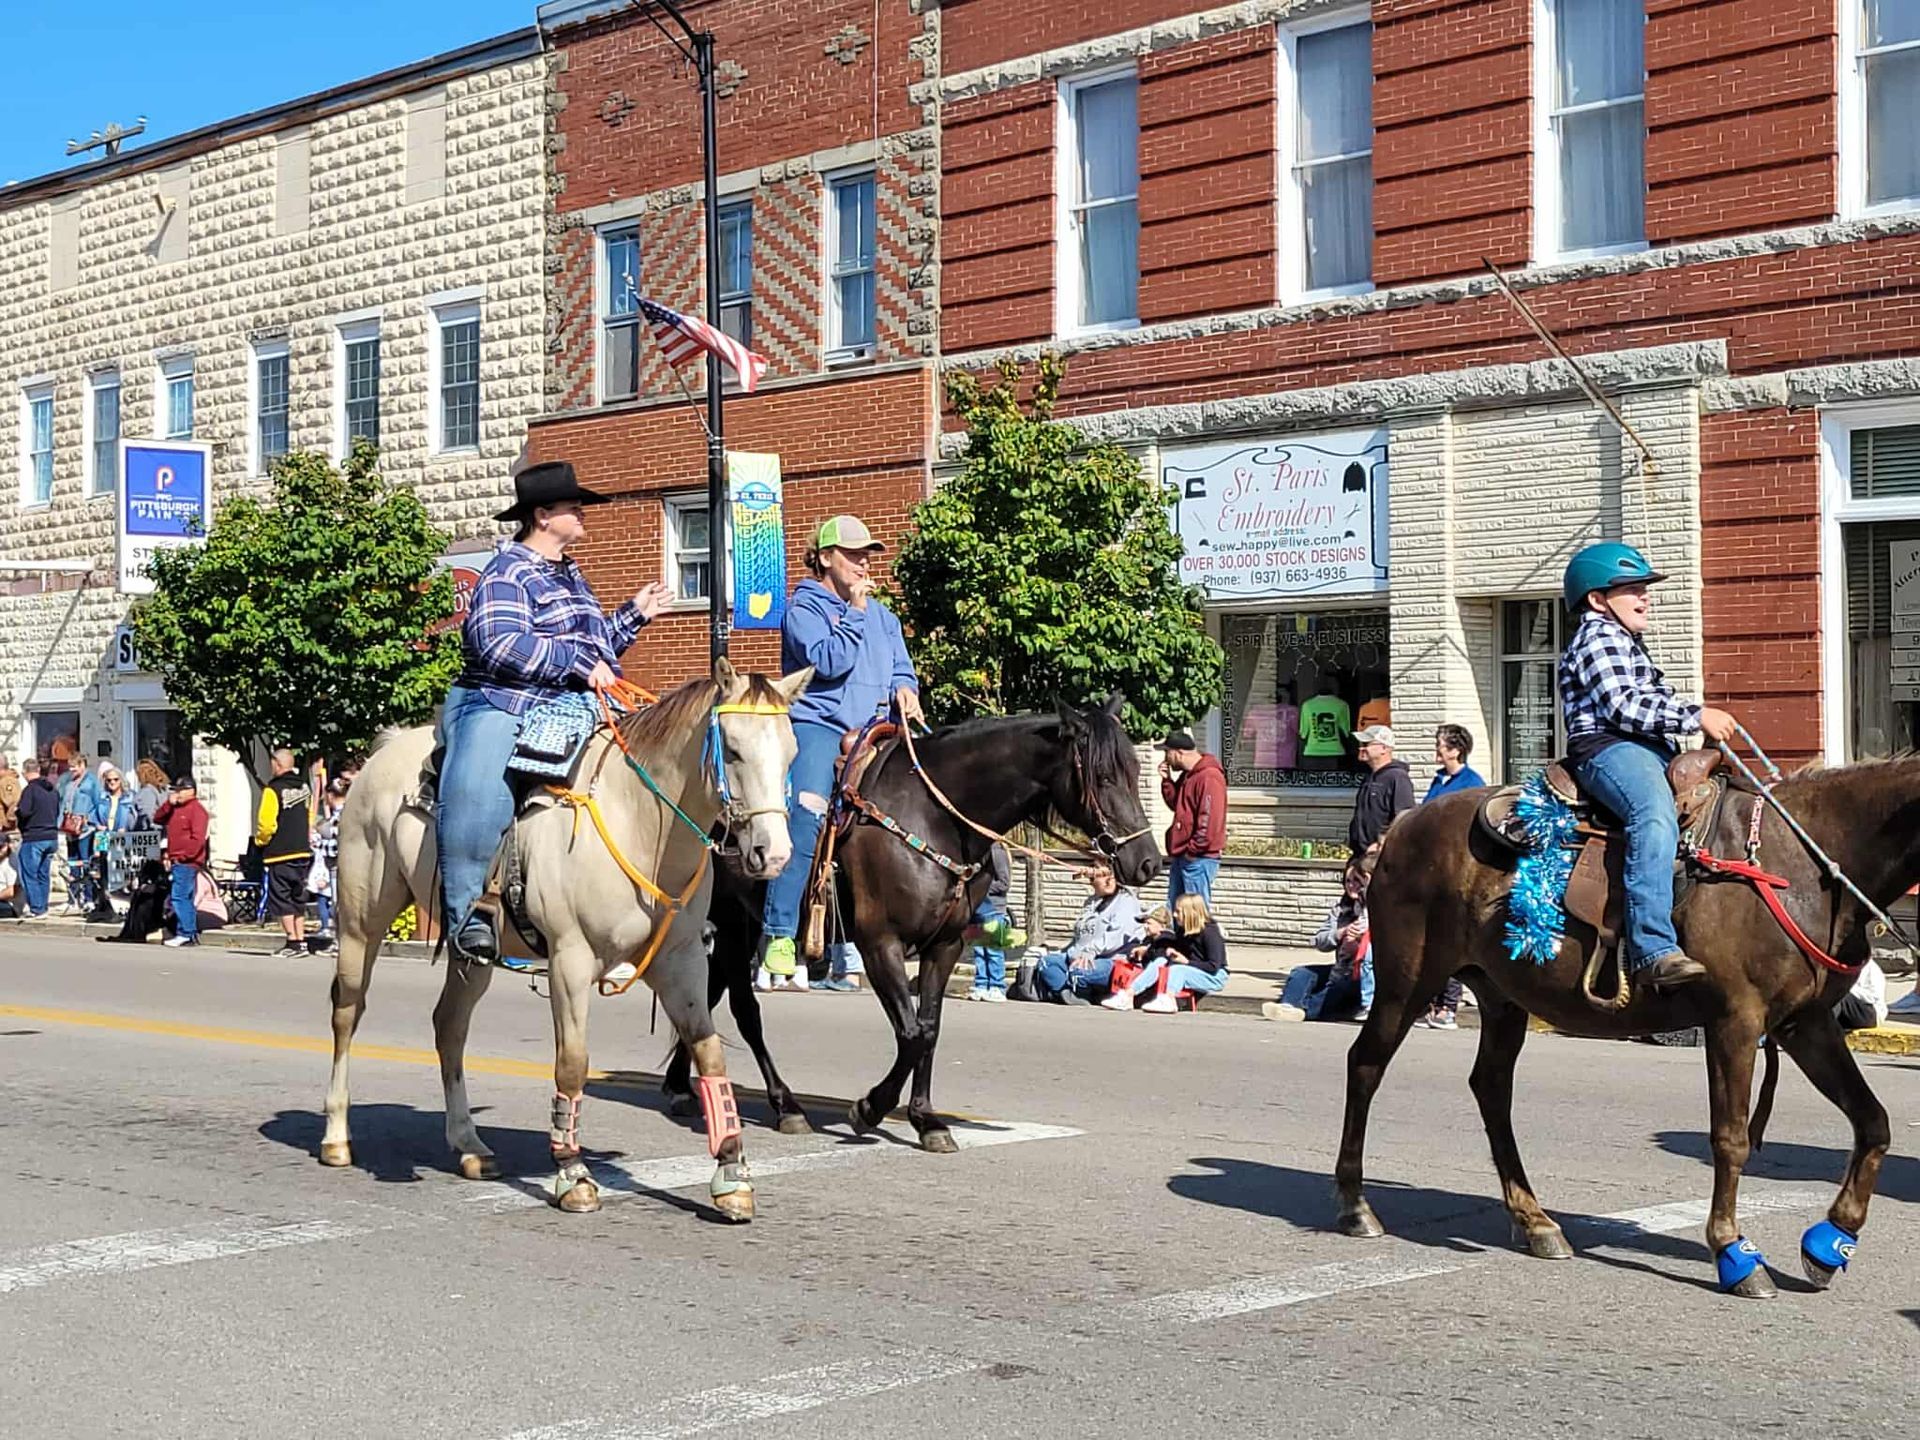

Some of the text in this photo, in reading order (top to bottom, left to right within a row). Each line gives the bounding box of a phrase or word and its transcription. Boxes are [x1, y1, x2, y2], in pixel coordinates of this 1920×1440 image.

[1223, 460, 1330, 503] St. Paris
[130, 500, 199, 512] PITTSBURGH
[1218, 498, 1336, 533] Embroidery
[1212, 534, 1341, 553] sew_happy@live.com
[1184, 556, 1214, 571] OVER
[1265, 551, 1306, 567] STOCK
[1311, 546, 1366, 564] DESIGNS
[1204, 567, 1347, 586] Phone: (937) 663-4936
